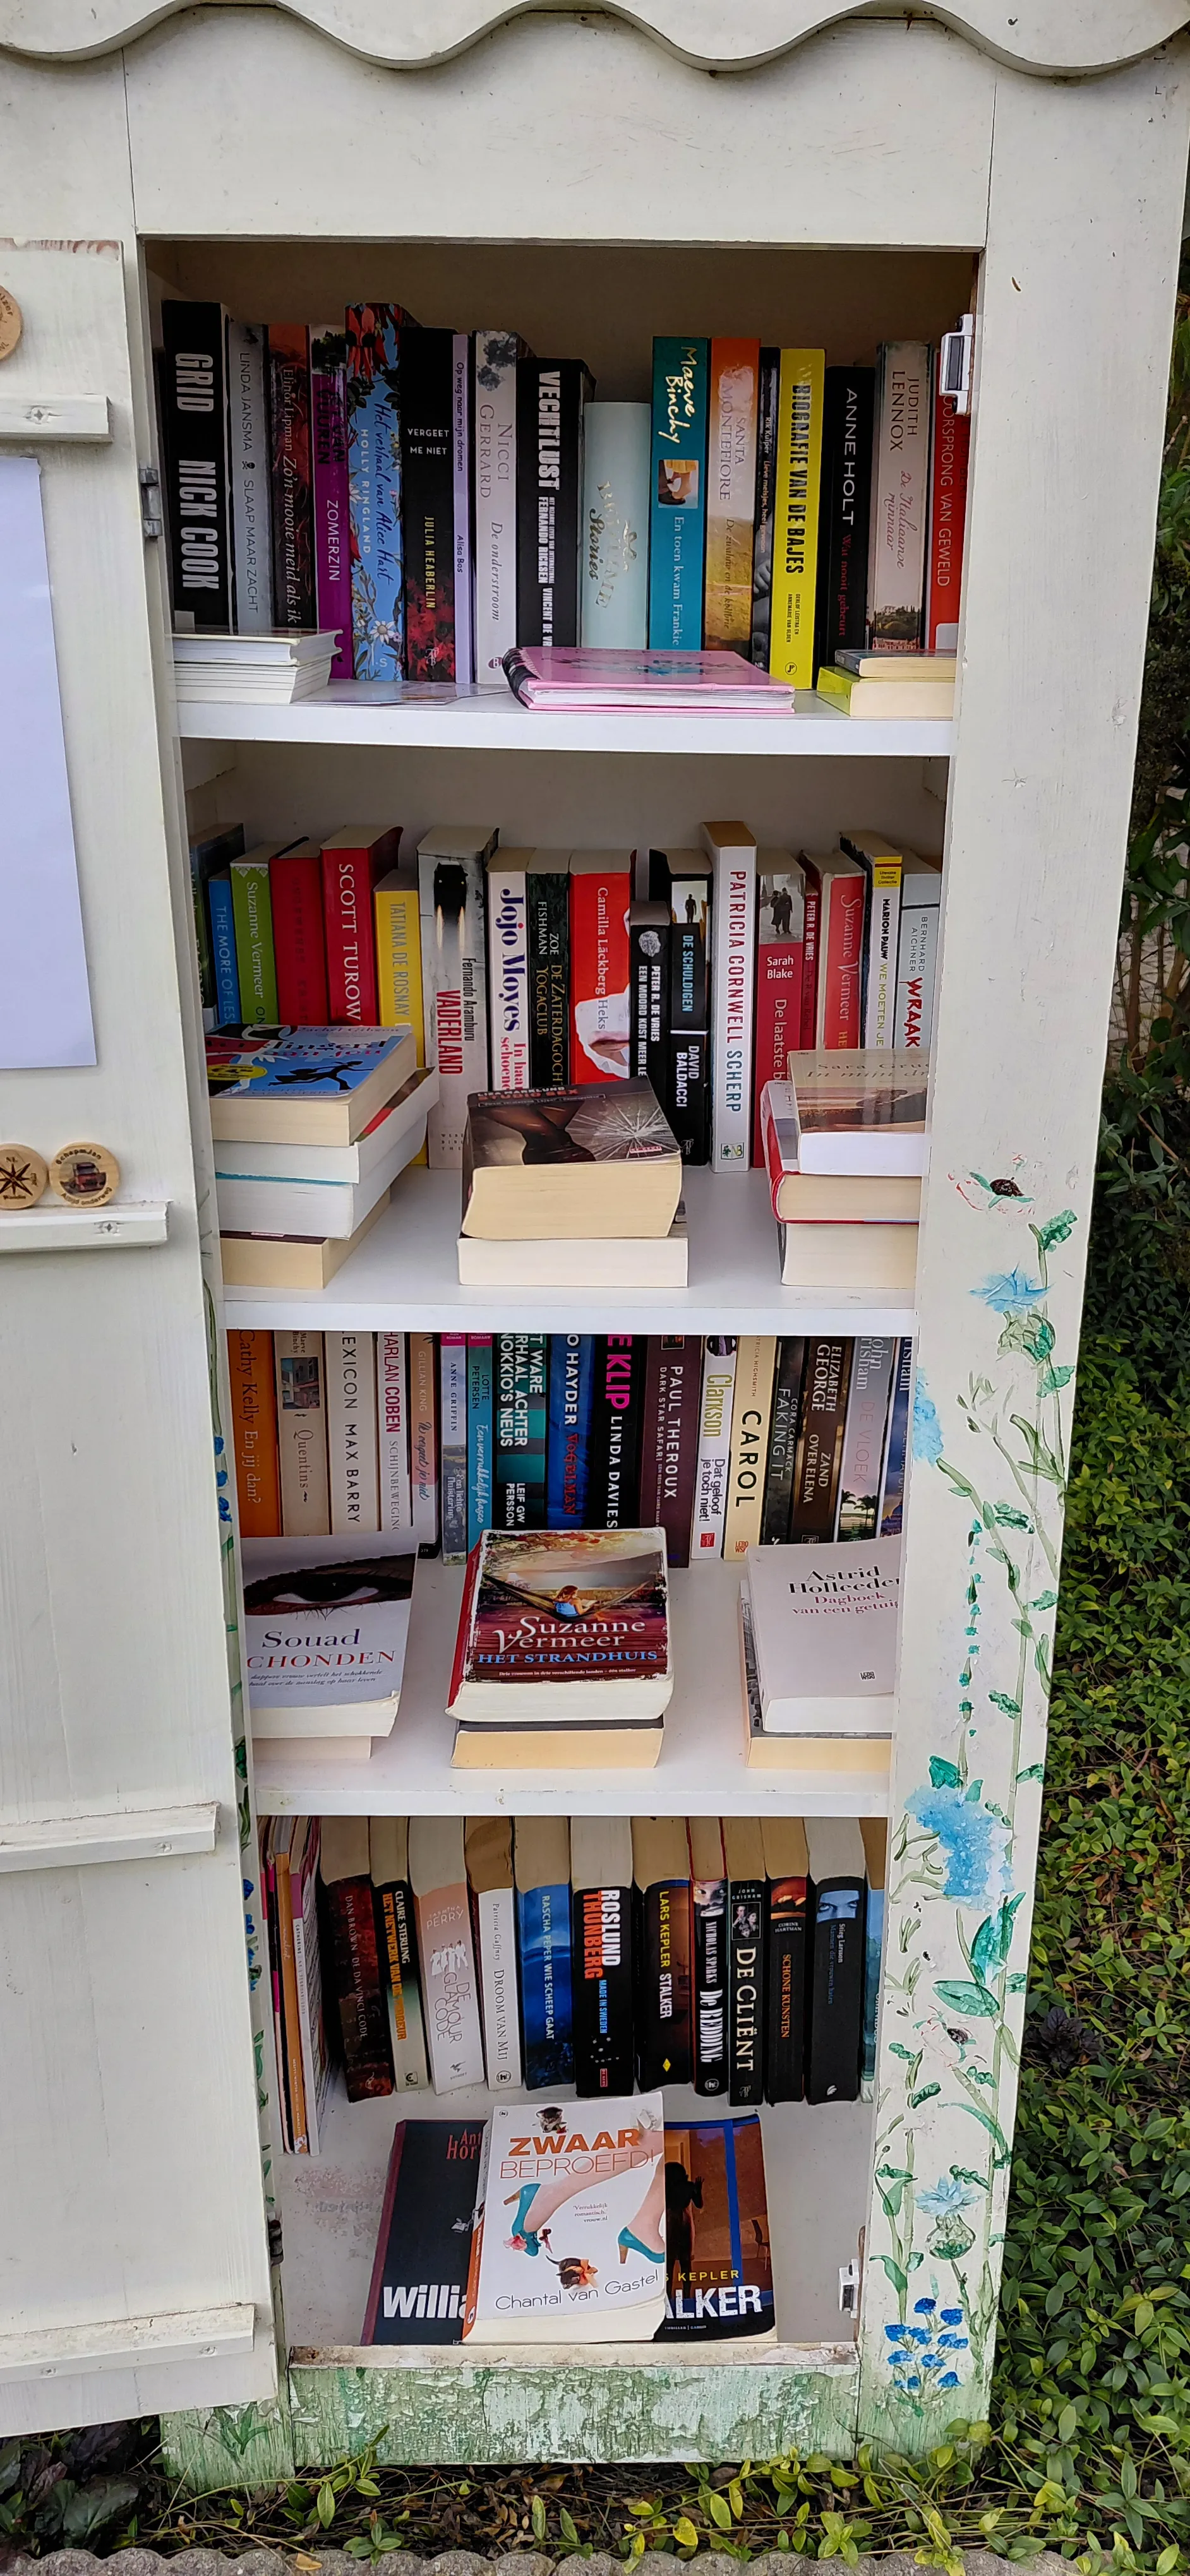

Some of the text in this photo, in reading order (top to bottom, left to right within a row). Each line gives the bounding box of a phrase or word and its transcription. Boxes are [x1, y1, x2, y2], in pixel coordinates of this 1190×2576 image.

[658, 376, 690, 444] Binchy
[680, 346, 697, 417] Maeve
[890, 371, 906, 451] LENNOX
[907, 378, 920, 436] JUDITH
[407, 428, 450, 438] VERGEET
[410, 446, 448, 455] ME NIET
[479, 404, 495, 499] GERRARD
[498, 423, 513, 481] NICCI
[538, 371, 561, 491] VECHTLUST
[719, 385, 734, 501] MONTEFIORE
[735, 417, 747, 465] SANTA
[842, 388, 858, 525] ANNE HOLT
[175, 353, 220, 590] GRID NICK COOK
[239, 352, 258, 613] LINDA JANSMA SLAAP MAAR ZACHT
[361, 429, 371, 554] HOLLY RINGLAND
[786, 385, 812, 574] BIOGRAFIE VAN DE BAJES
[327, 499, 341, 581] ZOMERZIN
[538, 496, 549, 584] FERNANDO RICKSEN
[883, 492, 896, 552] minnaar
[939, 492, 954, 522] VAN
[424, 516, 436, 609] JULIA HEABERLIN
[672, 516, 684, 645] En toen kwam Frankie
[937, 528, 953, 587] GEWELD
[246, 881, 263, 999] Suzanne Vermeer
[339, 863, 362, 1021] SCOTT TUROW
[389, 901, 410, 1017] TATIANA DE ROSNAY
[495, 888, 526, 1032] Jojo Moyes
[538, 901, 548, 955] FISHMAN
[549, 933, 559, 955] ZOE
[596, 886, 610, 1030] Camilla Läckberg Heks
[767, 955, 794, 967] Sarah
[910, 927, 918, 972] AICHNER
[918, 916, 929, 972] BERNHARD
[462, 957, 478, 1041] Fernando Aramburu
[536, 966, 549, 1035] YOGACLUB
[682, 935, 694, 1013] DE SCHULDIGEN
[725, 870, 748, 1113] PATRICIA CORNWELL SCHERP
[767, 969, 794, 979] Blake
[436, 989, 464, 1075] VADERLAND
[688, 1045, 700, 1080] DAVID
[772, 999, 788, 1068] De laatste
[676, 1052, 688, 1107] BALDACCI
[472, 1365, 480, 1409] PETERSEN
[481, 1374, 490, 1400] LOTTE
[529, 1349, 543, 1394] WARE
[811, 1344, 831, 1412] GEORGE
[826, 1346, 842, 1412] ELIZABETH
[341, 1331, 361, 1524] EXICON MAX BARRY
[500, 1407, 514, 1447] NEUS
[515, 1390, 529, 1447] ACHTER
[656, 1366, 668, 1462] DARK STAR SAFARI
[664, 1366, 683, 1498] PAUL THEROUX
[703, 1374, 733, 1438] Clarkson
[771, 1388, 791, 1481] FAKING IT
[293, 1428, 314, 1489] Quentins
[605, 1354, 632, 1529] KLIP LINDA DAVIES
[735, 1410, 762, 1508] CAROL
[818, 1452, 831, 1488] ZAND
[853, 1401, 875, 1484] DE VLOEK
[506, 1482, 515, 1527] PERSSON
[711, 1458, 726, 1515] Dat geloof
[806, 1566, 880, 1582] Astrid
[814, 1592, 886, 1606] Dagboek
[246, 1650, 396, 1669] CHONDEN
[261, 1628, 360, 1649] Souad
[478, 1650, 658, 1664] HET STRANDHUIS
[493, 1629, 625, 1654] Vermeer
[395, 1890, 411, 1964] CLAIRE STERLING
[426, 1909, 464, 1930] PERRY
[582, 1891, 604, 1980] THUNBERG
[600, 1890, 621, 1967] ROSLUND
[836, 1923, 846, 1939] Stieg
[492, 1902, 508, 2061] Patricia Gaffney DROOM VAN MIJ
[541, 1895, 555, 2041] RASCHA PEPER WIE SCHEEP GAAT
[659, 1891, 672, 2019] LARS KEPLER STALKER
[736, 1947, 758, 2072] DE CLIËNT
[781, 1953, 791, 2038] SCHONE KUNSTEN
[500, 2150, 655, 2179] BEPROEFD!
[508, 2128, 640, 2157] ZWAAR
[495, 2269, 659, 2311] Chantal van Gastel
[678, 2270, 740, 2282] KEPLER
